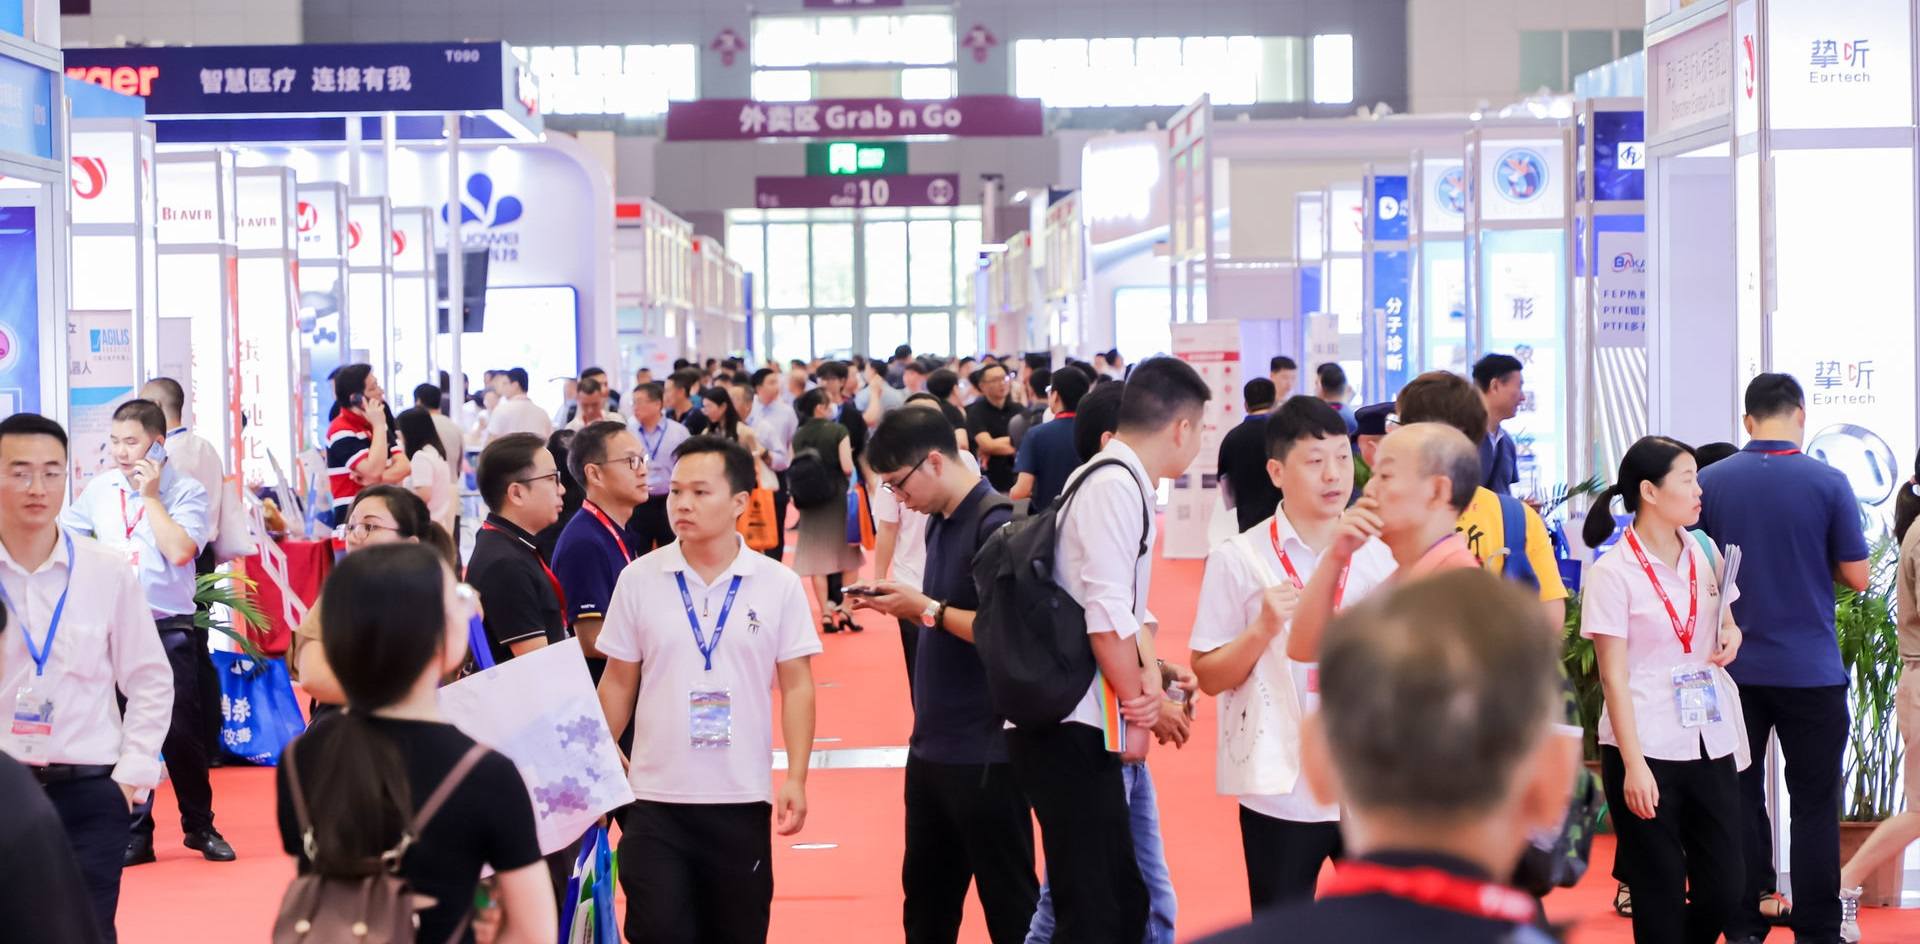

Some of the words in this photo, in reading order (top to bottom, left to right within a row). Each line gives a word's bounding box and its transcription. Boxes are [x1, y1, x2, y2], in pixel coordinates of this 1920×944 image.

[1810, 39, 1870, 68] 挚听
[200, 66, 297, 94] 智慧医疗
[311, 66, 412, 92] 连接有我
[1809, 71, 1871, 83] Eartech
[739, 105, 820, 133] 外卖区
[825, 105, 892, 130] Grab
[898, 110, 916, 128] n
[922, 105, 962, 129] Go
[859, 179, 889, 206] 10
[162, 206, 212, 221] BEAVER
[1385, 295, 1403, 372] 分子诊断
[1813, 360, 1875, 389] 挚听
[1813, 393, 1876, 405] Eartech
